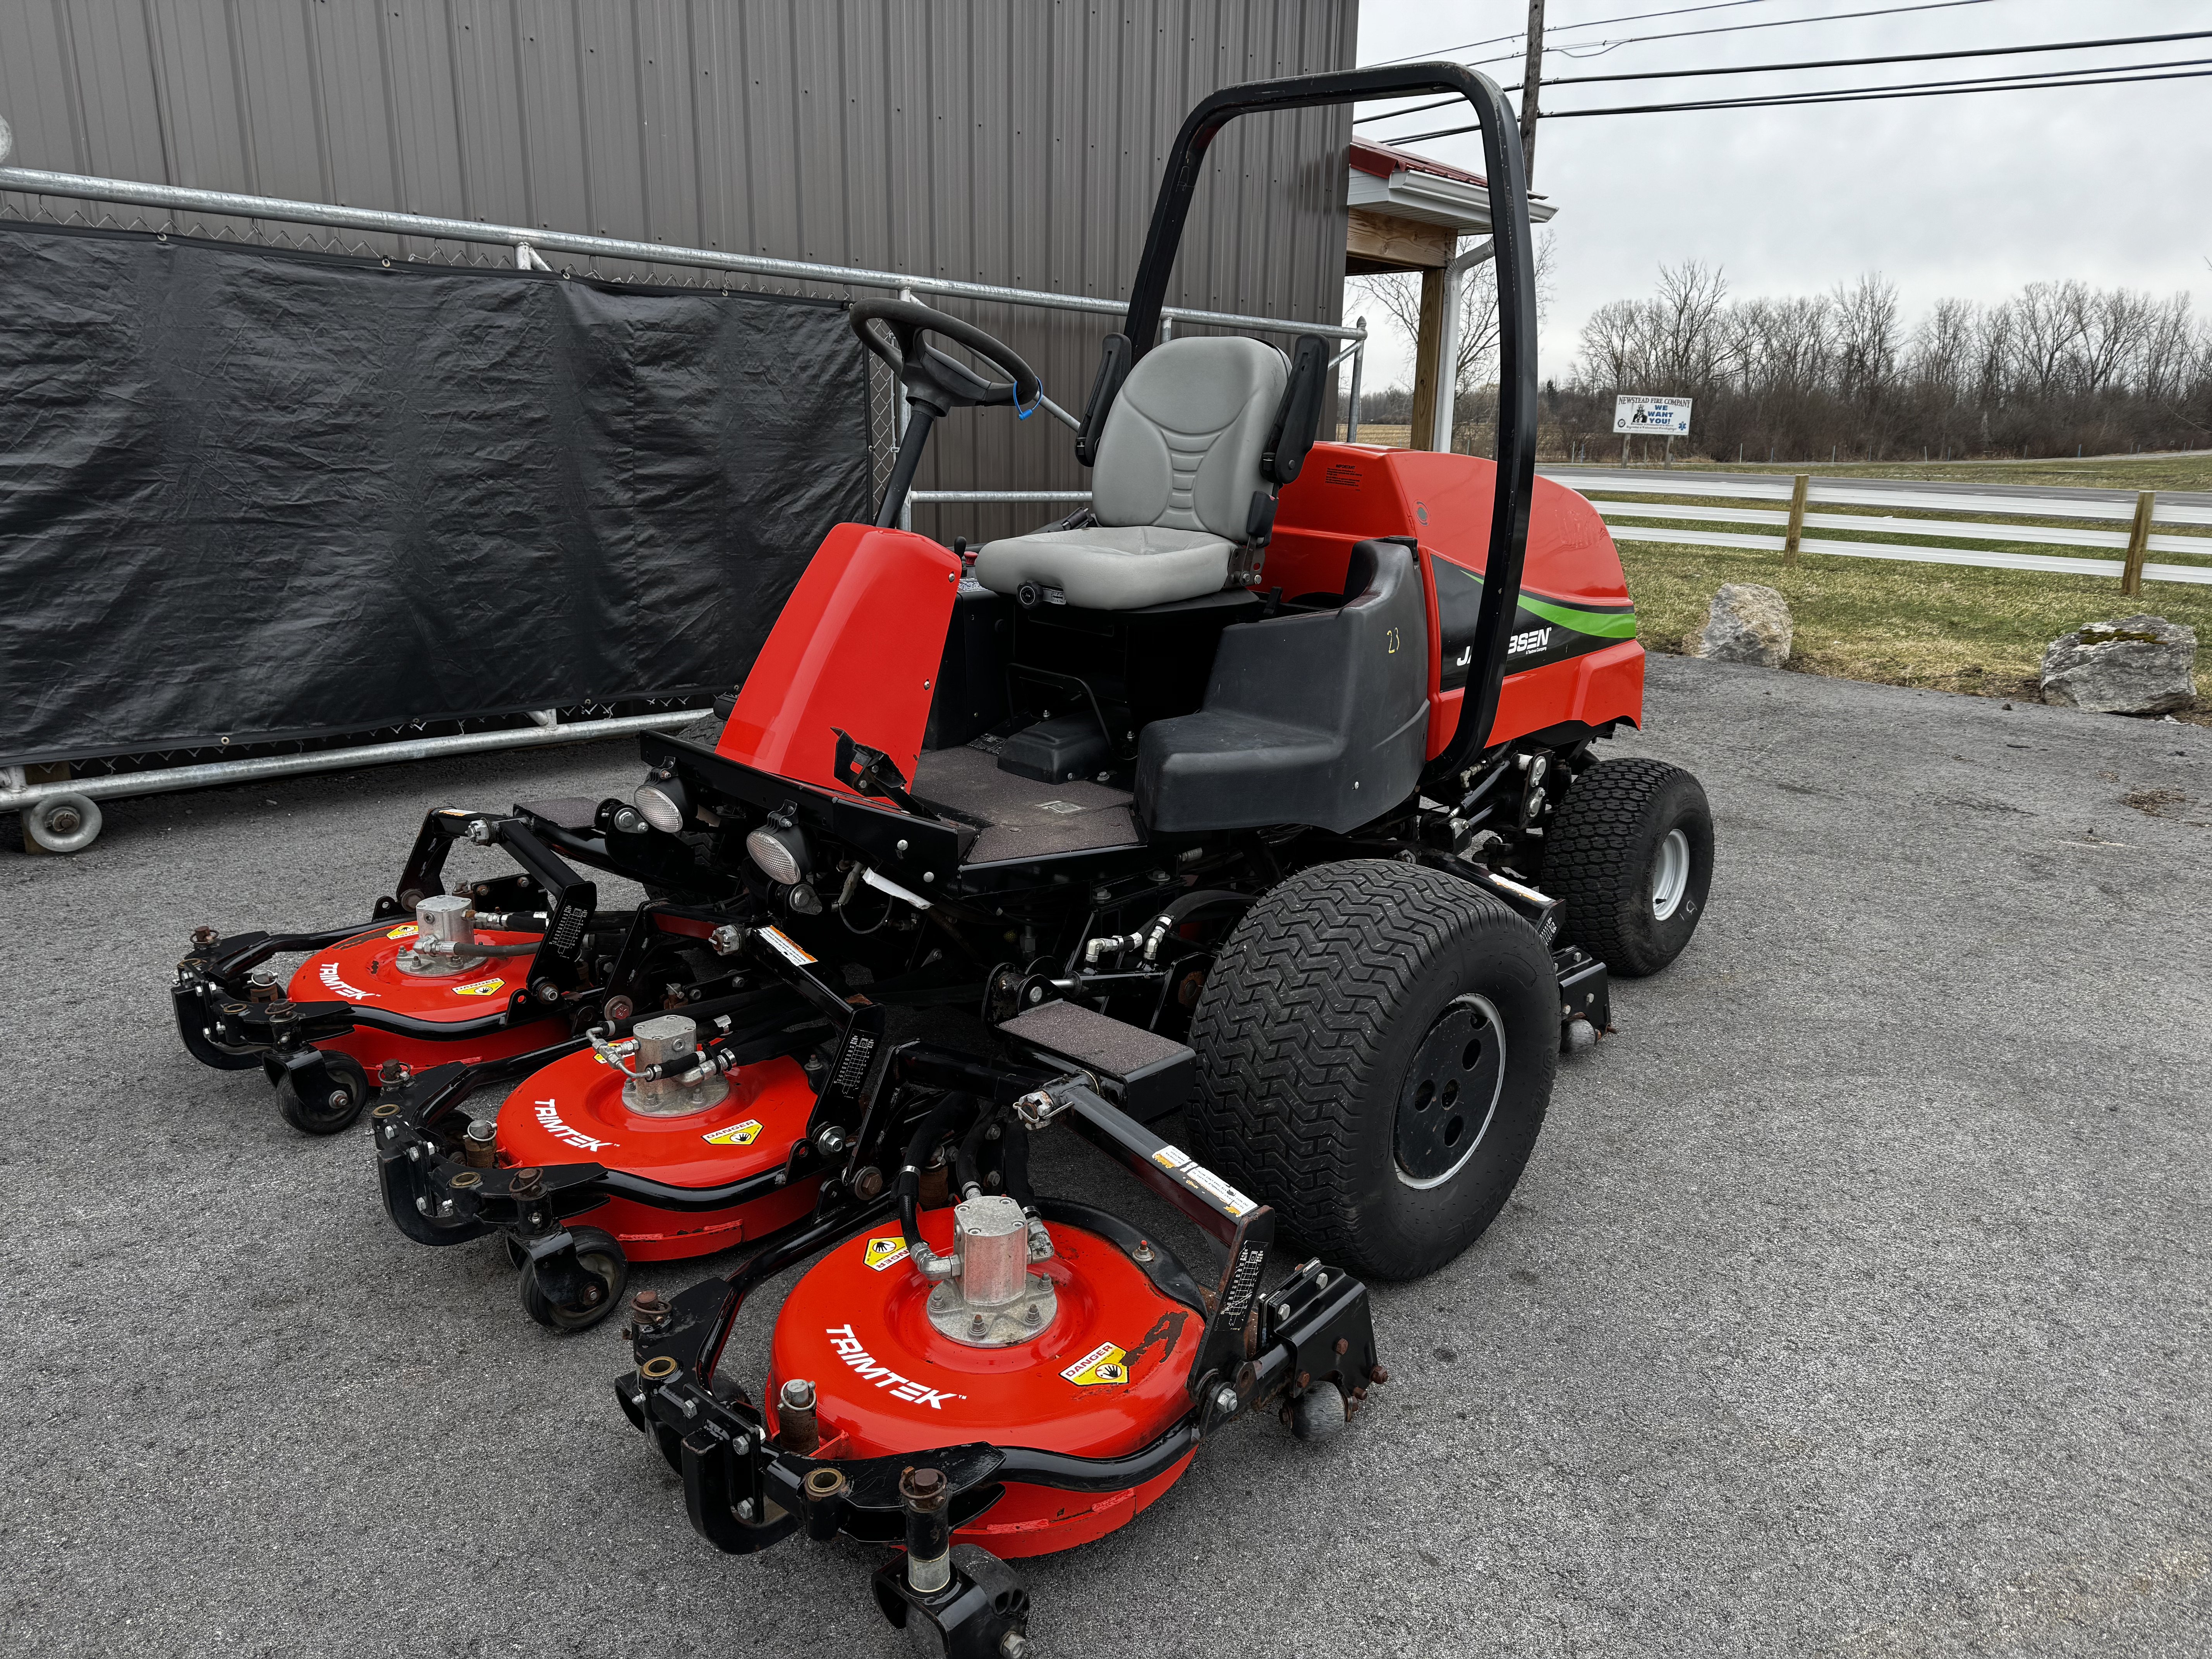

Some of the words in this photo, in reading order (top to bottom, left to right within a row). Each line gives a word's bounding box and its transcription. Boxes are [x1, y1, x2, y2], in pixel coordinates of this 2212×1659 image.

[1618, 397, 1649, 405] NEWSTEAD
[1664, 398, 1691, 408] COMPANY
[1457, 627, 1550, 666] JBSEN
[319, 962, 376, 1000] TRIMTEK
[455, 979, 498, 990] DANGER
[535, 1099, 613, 1152] TRIMTEK
[706, 1121, 754, 1139] DANGER
[876, 1249, 909, 1268] NGER
[826, 1324, 957, 1410] TRIMTEK
[1066, 1345, 1113, 1377] DANGER
